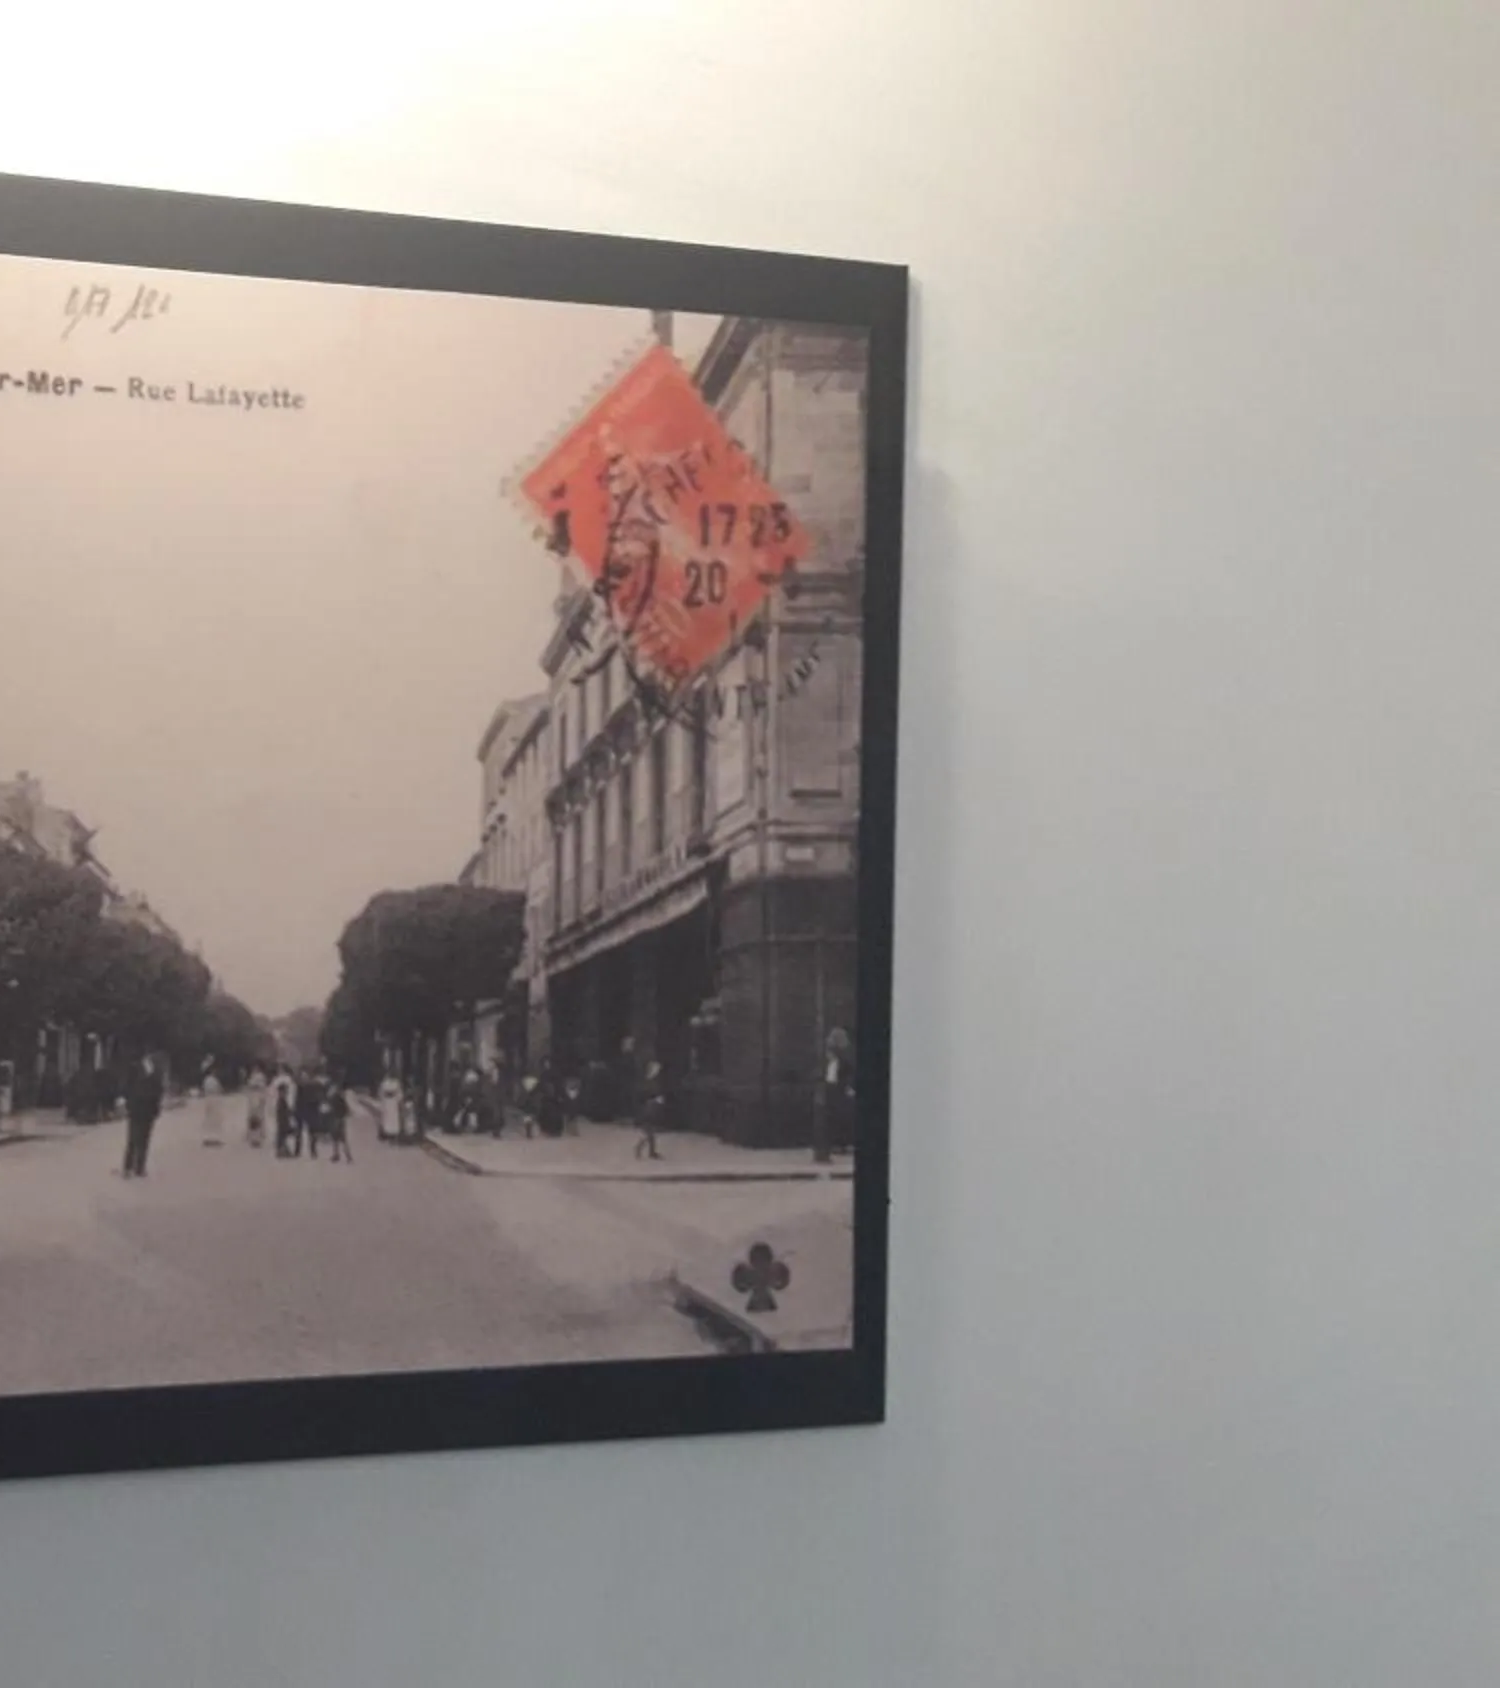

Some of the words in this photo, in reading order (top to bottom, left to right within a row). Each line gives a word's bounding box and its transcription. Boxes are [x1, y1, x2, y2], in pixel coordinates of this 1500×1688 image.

[127, 376, 176, 402] Rue
[187, 381, 306, 411] Lafayette
[683, 559, 729, 608] 20
